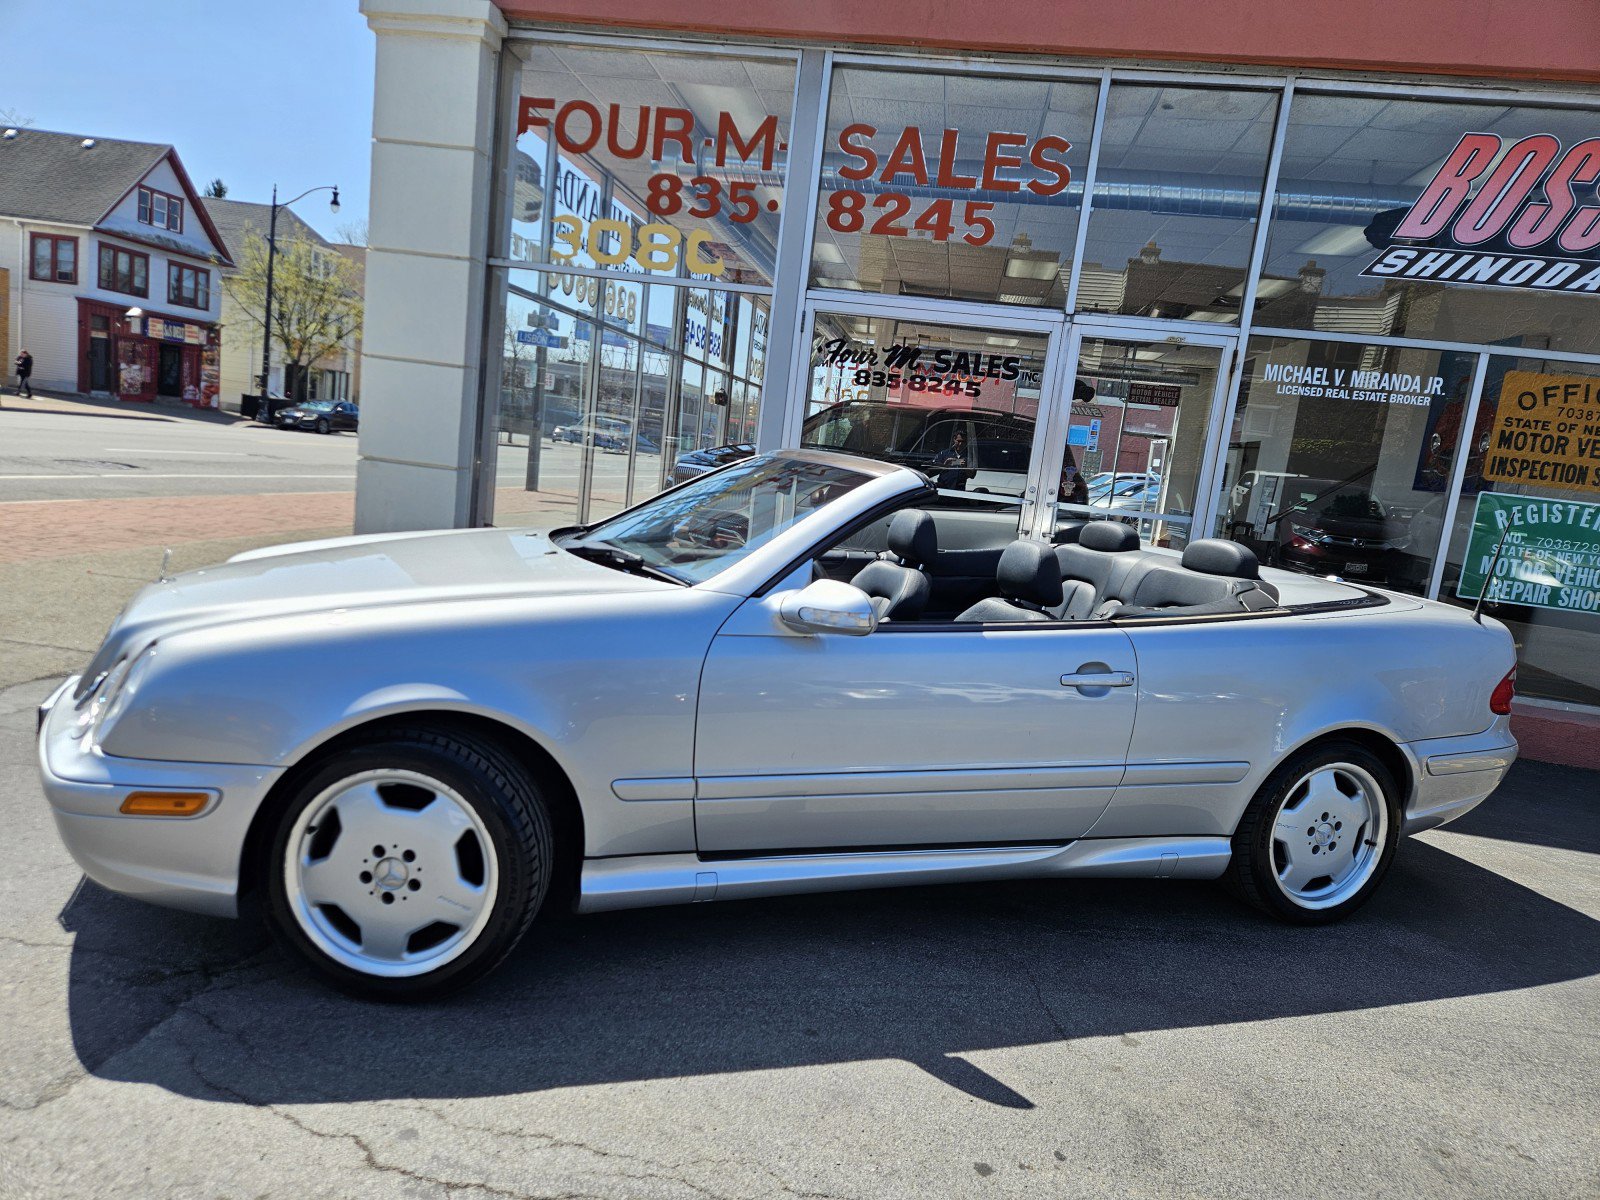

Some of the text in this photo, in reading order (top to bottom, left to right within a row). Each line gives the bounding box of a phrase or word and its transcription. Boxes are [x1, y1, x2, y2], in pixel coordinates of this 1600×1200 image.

[838, 123, 1072, 196] SALES
[826, 190, 996, 247] 8245
[1372, 250, 1600, 291] SHINODA
[519, 331, 548, 345] LISBON
[882, 344, 922, 370] M
[934, 350, 1021, 380] SALES
[1131, 387, 1179, 399] MOTOR VEHICLE
[1264, 364, 1446, 396] MICHAEL V. MIRANDA JR.
[1130, 395, 1177, 406] RETAIL DEALER
[1276, 384, 1431, 407] LICENSED REAL ESTATE BROKER
[1518, 384, 1600, 411] OFFI
[1504, 416, 1551, 431] STATE
[1557, 422, 1579, 434] OF
[1497, 429, 1570, 456] MOTOR
[1489, 456, 1589, 485] INSPECTION
[1491, 544, 1533, 560] STATE
[1535, 549, 1553, 561] OF
[1557, 552, 1585, 564] NEW
[1504, 532, 1600, 555] NO. 7038729
[1480, 555, 1547, 579] MOTOR
[1489, 578, 1552, 605] REPAIR
